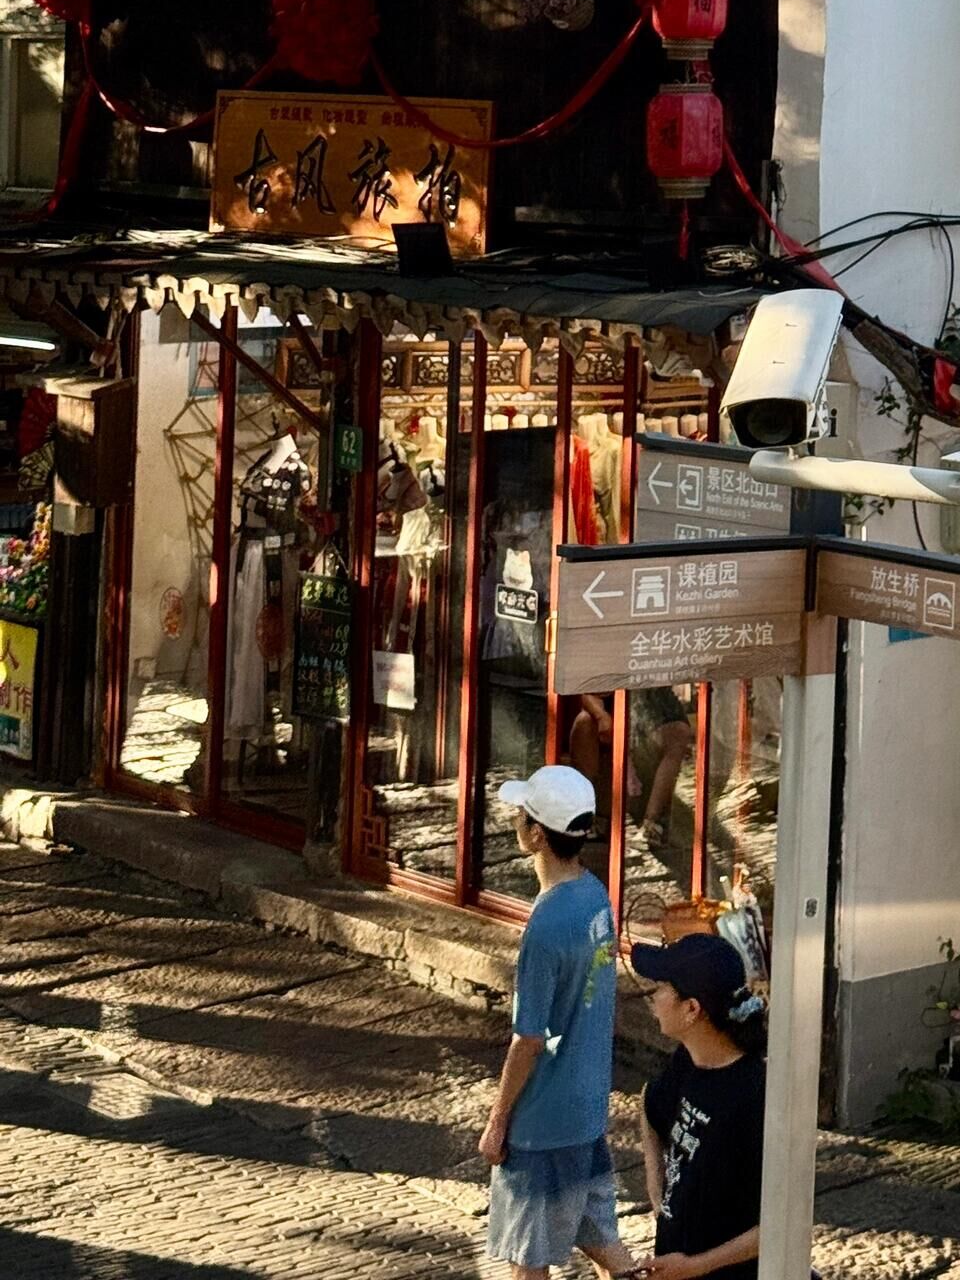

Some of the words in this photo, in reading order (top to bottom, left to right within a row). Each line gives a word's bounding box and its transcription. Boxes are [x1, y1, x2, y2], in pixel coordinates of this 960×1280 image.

[706, 466, 778, 498] 景区北出口
[677, 561, 738, 587] 课植园
[871, 566, 920, 597] 放生桥
[676, 588, 702, 601] Kezhi
[704, 587, 739, 600] Garden
[630, 622, 774, 657] 全华水彩艺术馆
[628, 657, 673, 671] Quanhua
[674, 656, 689, 667] Art
[690, 653, 724, 666] Gallery
